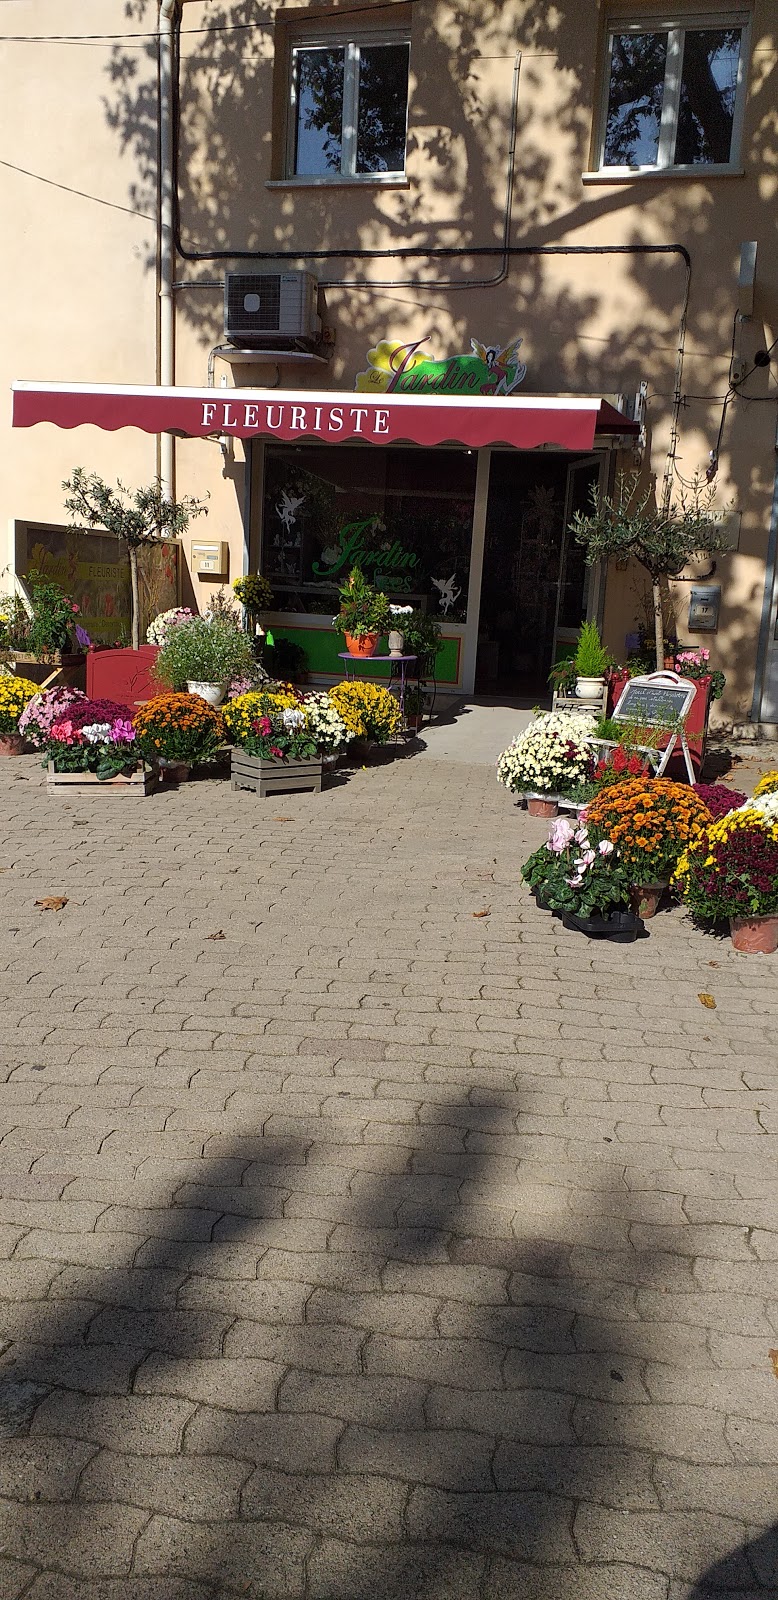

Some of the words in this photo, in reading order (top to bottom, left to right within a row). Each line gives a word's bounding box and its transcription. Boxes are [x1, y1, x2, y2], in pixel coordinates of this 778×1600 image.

[386, 336, 480, 394] Jardin
[201, 403, 391, 434] FLEURISTE
[312, 518, 420, 576] Jardin
[88, 565, 125, 579] FLEURISTE
